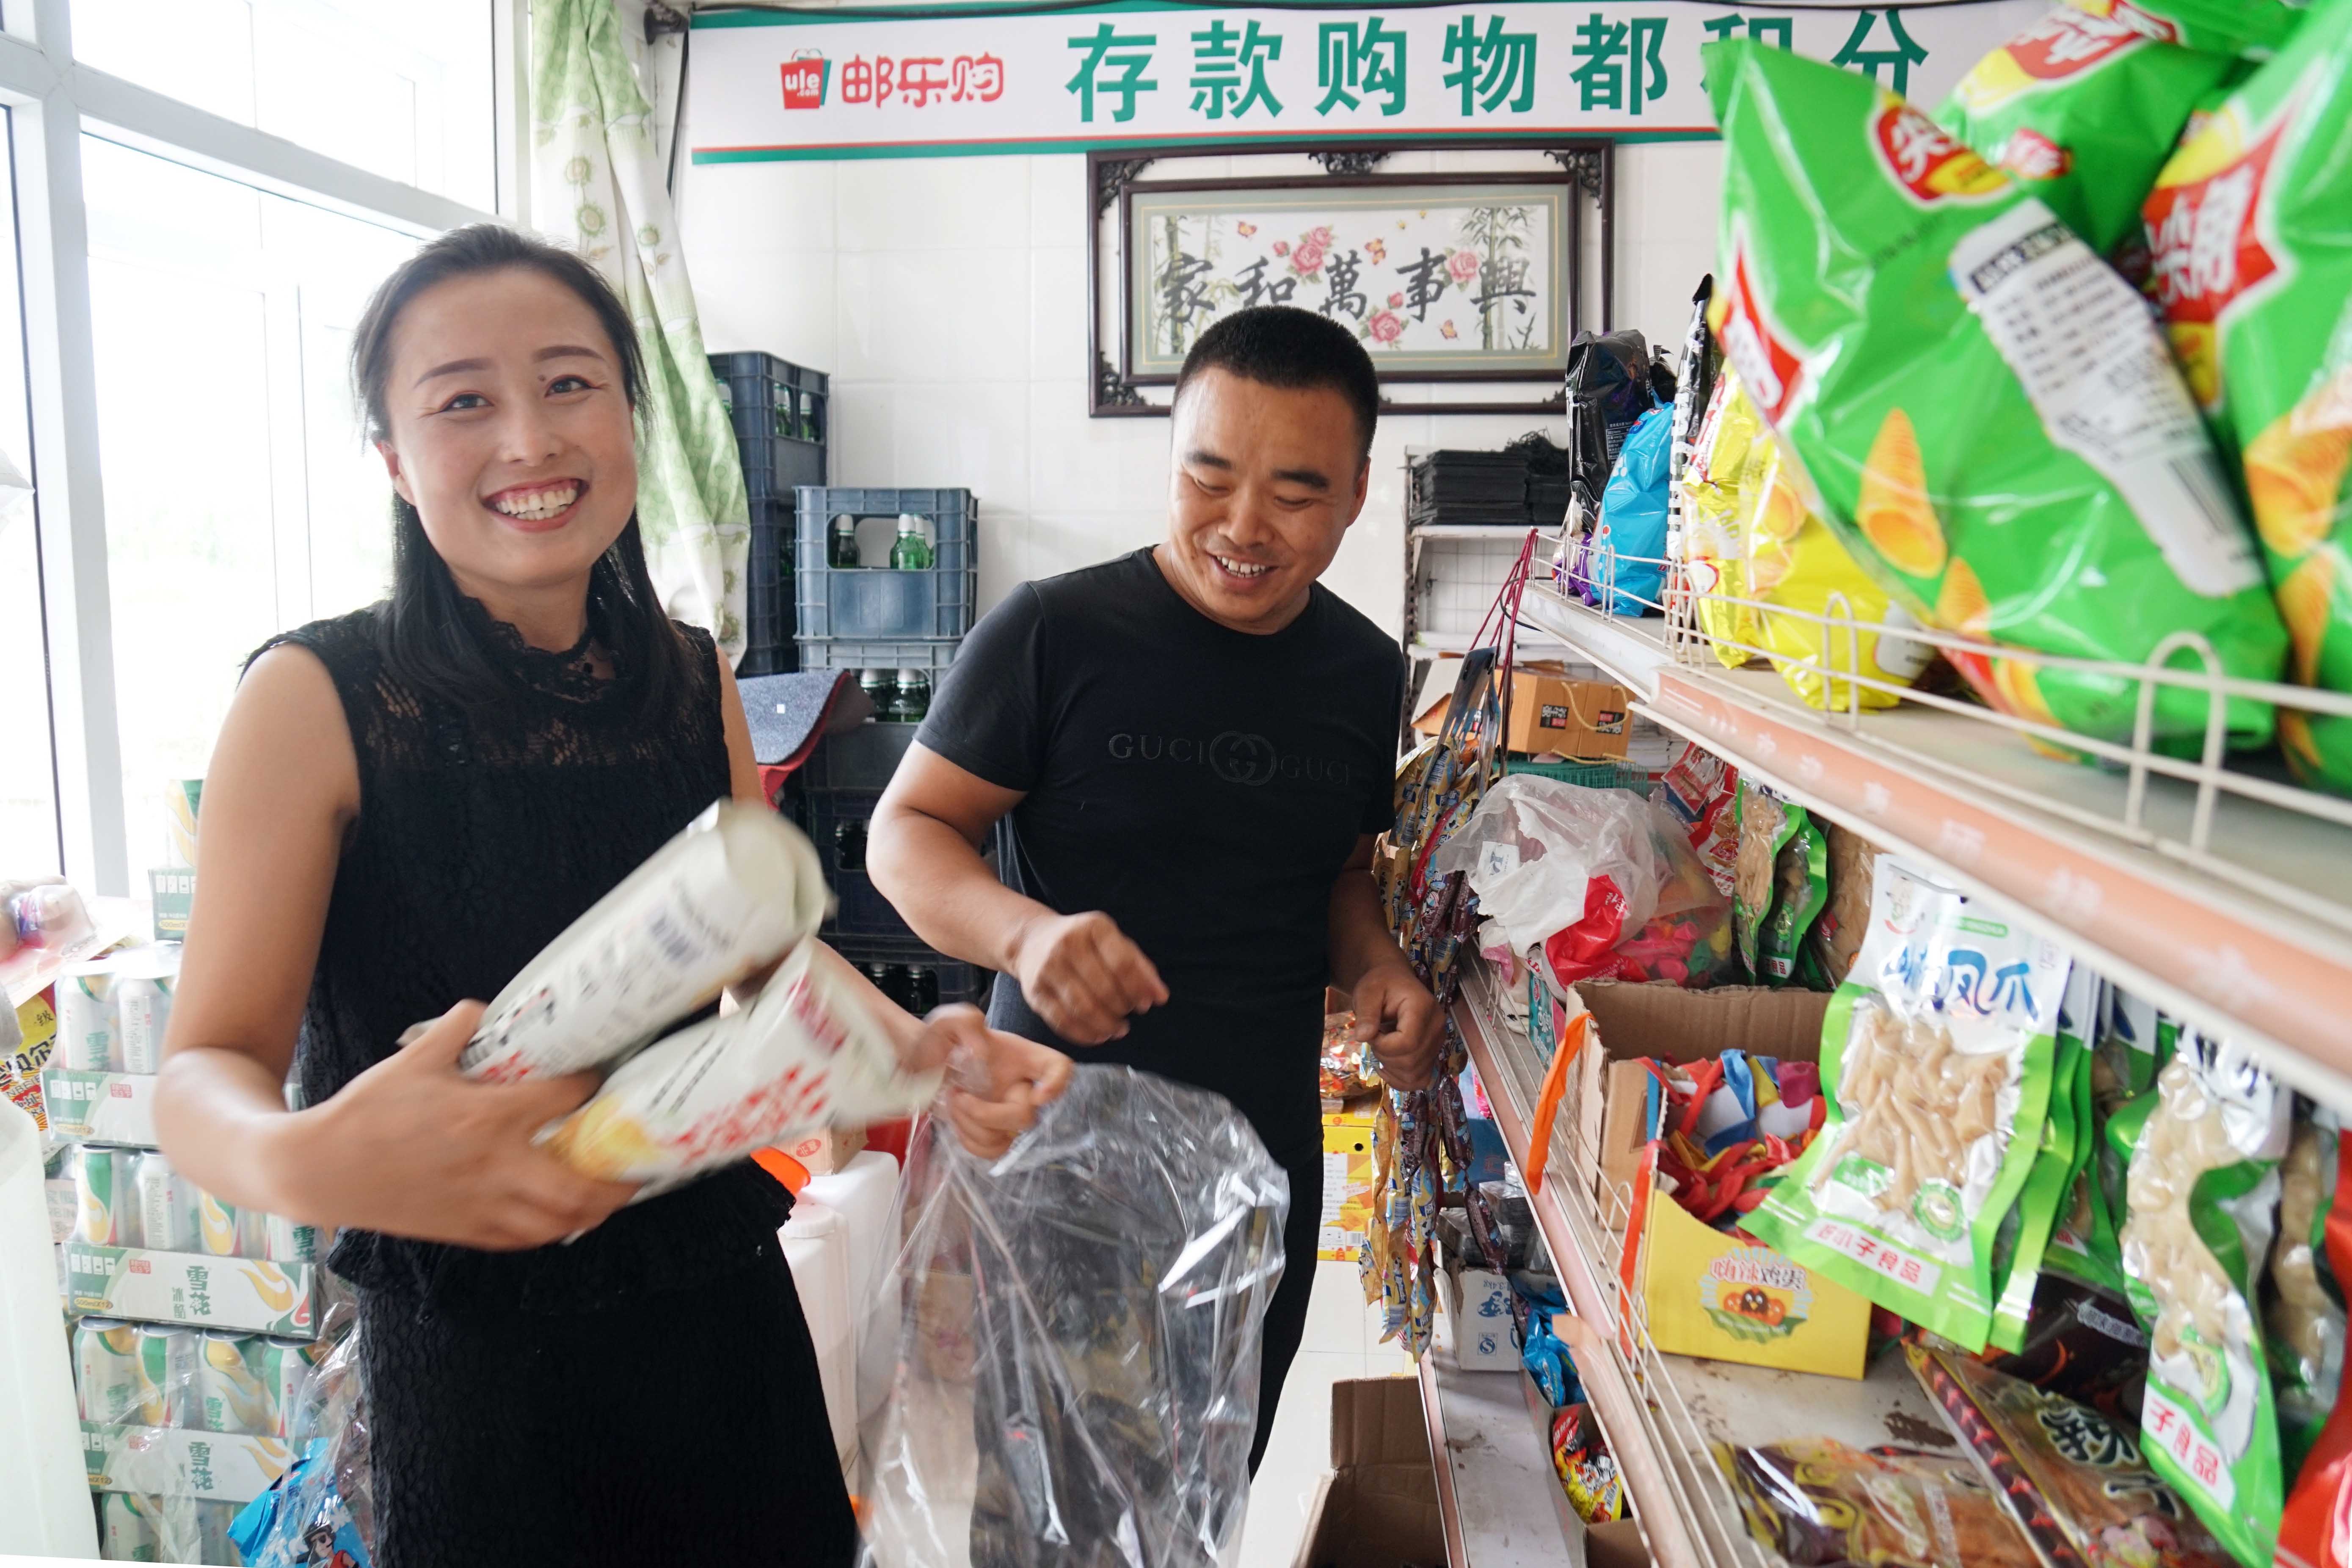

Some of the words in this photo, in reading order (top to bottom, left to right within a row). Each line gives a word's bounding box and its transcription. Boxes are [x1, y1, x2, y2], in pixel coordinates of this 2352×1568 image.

[785, 69, 820, 91] ule
[841, 51, 1004, 109] 邮乐购
[1161, 247, 1536, 325] 家和萬事興
[186, 1265, 211, 1315] 雪花
[188, 1441, 214, 1491] 雪花
